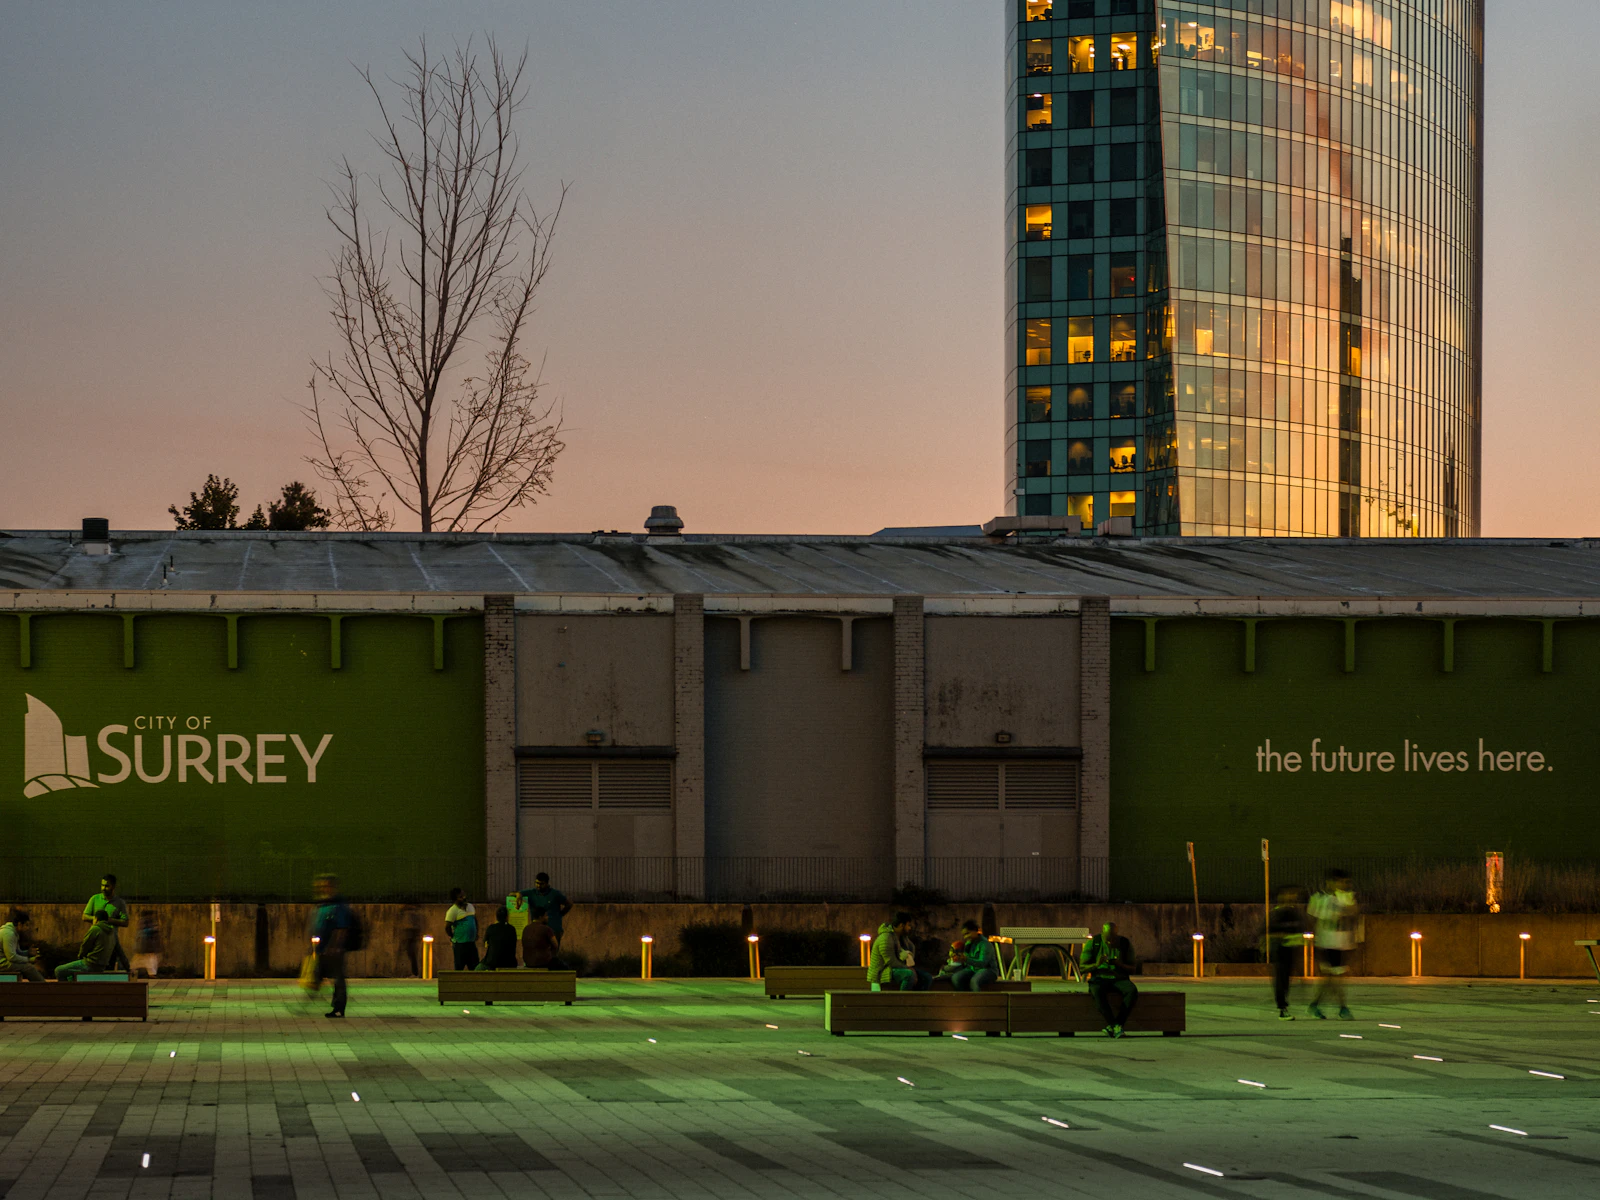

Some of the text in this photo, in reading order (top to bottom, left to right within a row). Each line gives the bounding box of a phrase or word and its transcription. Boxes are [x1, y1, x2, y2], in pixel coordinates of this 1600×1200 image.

[134, 715, 212, 730] CITY OF
[97, 724, 334, 785] SURREY
[1255, 737, 1553, 773] the future lives here.
